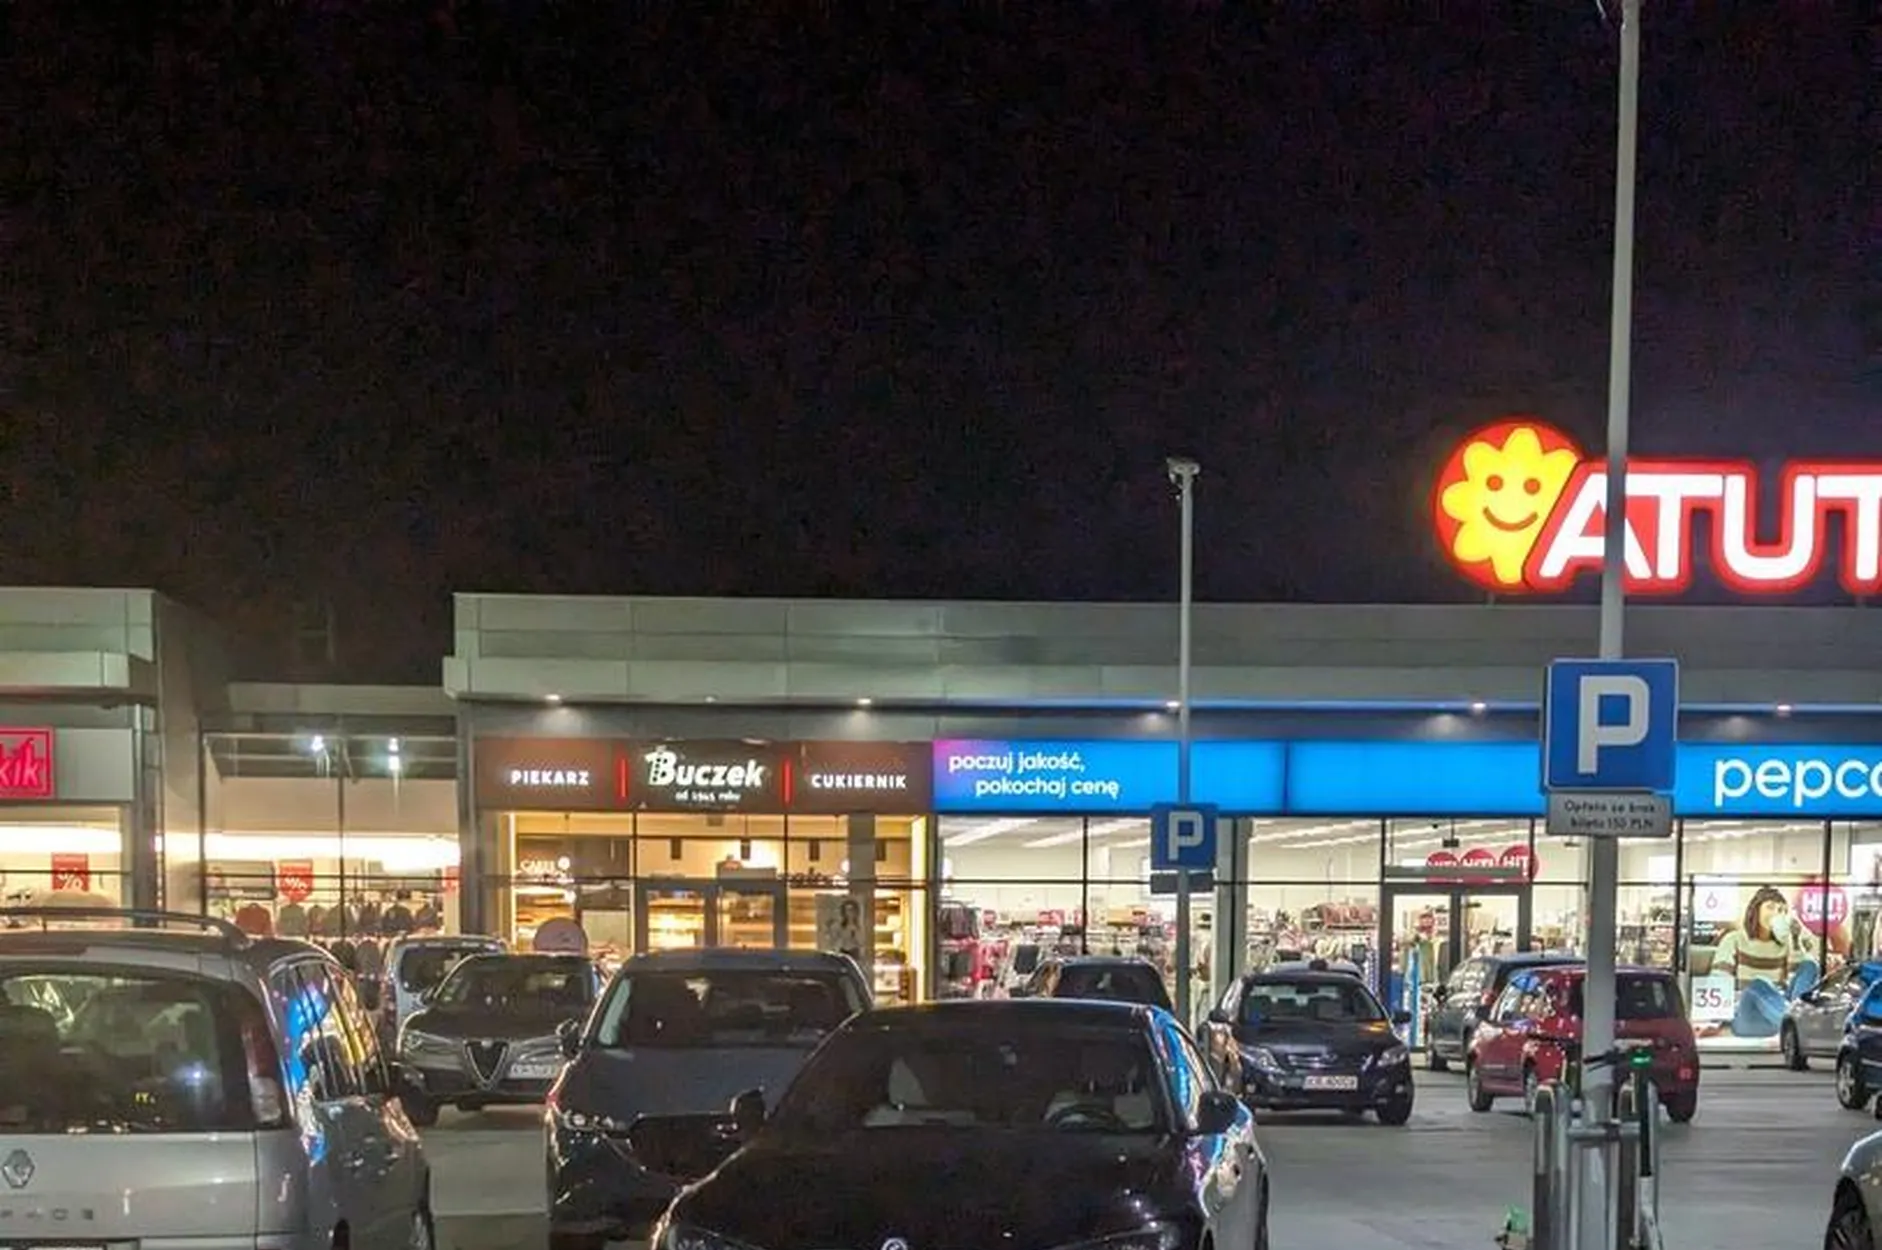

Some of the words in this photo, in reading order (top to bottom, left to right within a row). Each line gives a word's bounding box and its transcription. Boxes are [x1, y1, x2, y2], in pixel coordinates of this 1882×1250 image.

[1539, 473, 1882, 580] ATUT
[1577, 675, 1650, 775] P
[644, 745, 765, 787] Buczek
[949, 752, 1013, 774] poczuj
[1017, 752, 1085, 774] jakość,
[510, 769, 590, 787] PIEKARZ
[810, 773, 907, 789] CUKIERNIK
[974, 777, 1067, 799] pokochaj
[1070, 780, 1119, 800] cenę
[1167, 811, 1204, 861] P
[1694, 987, 1722, 1009] 35
